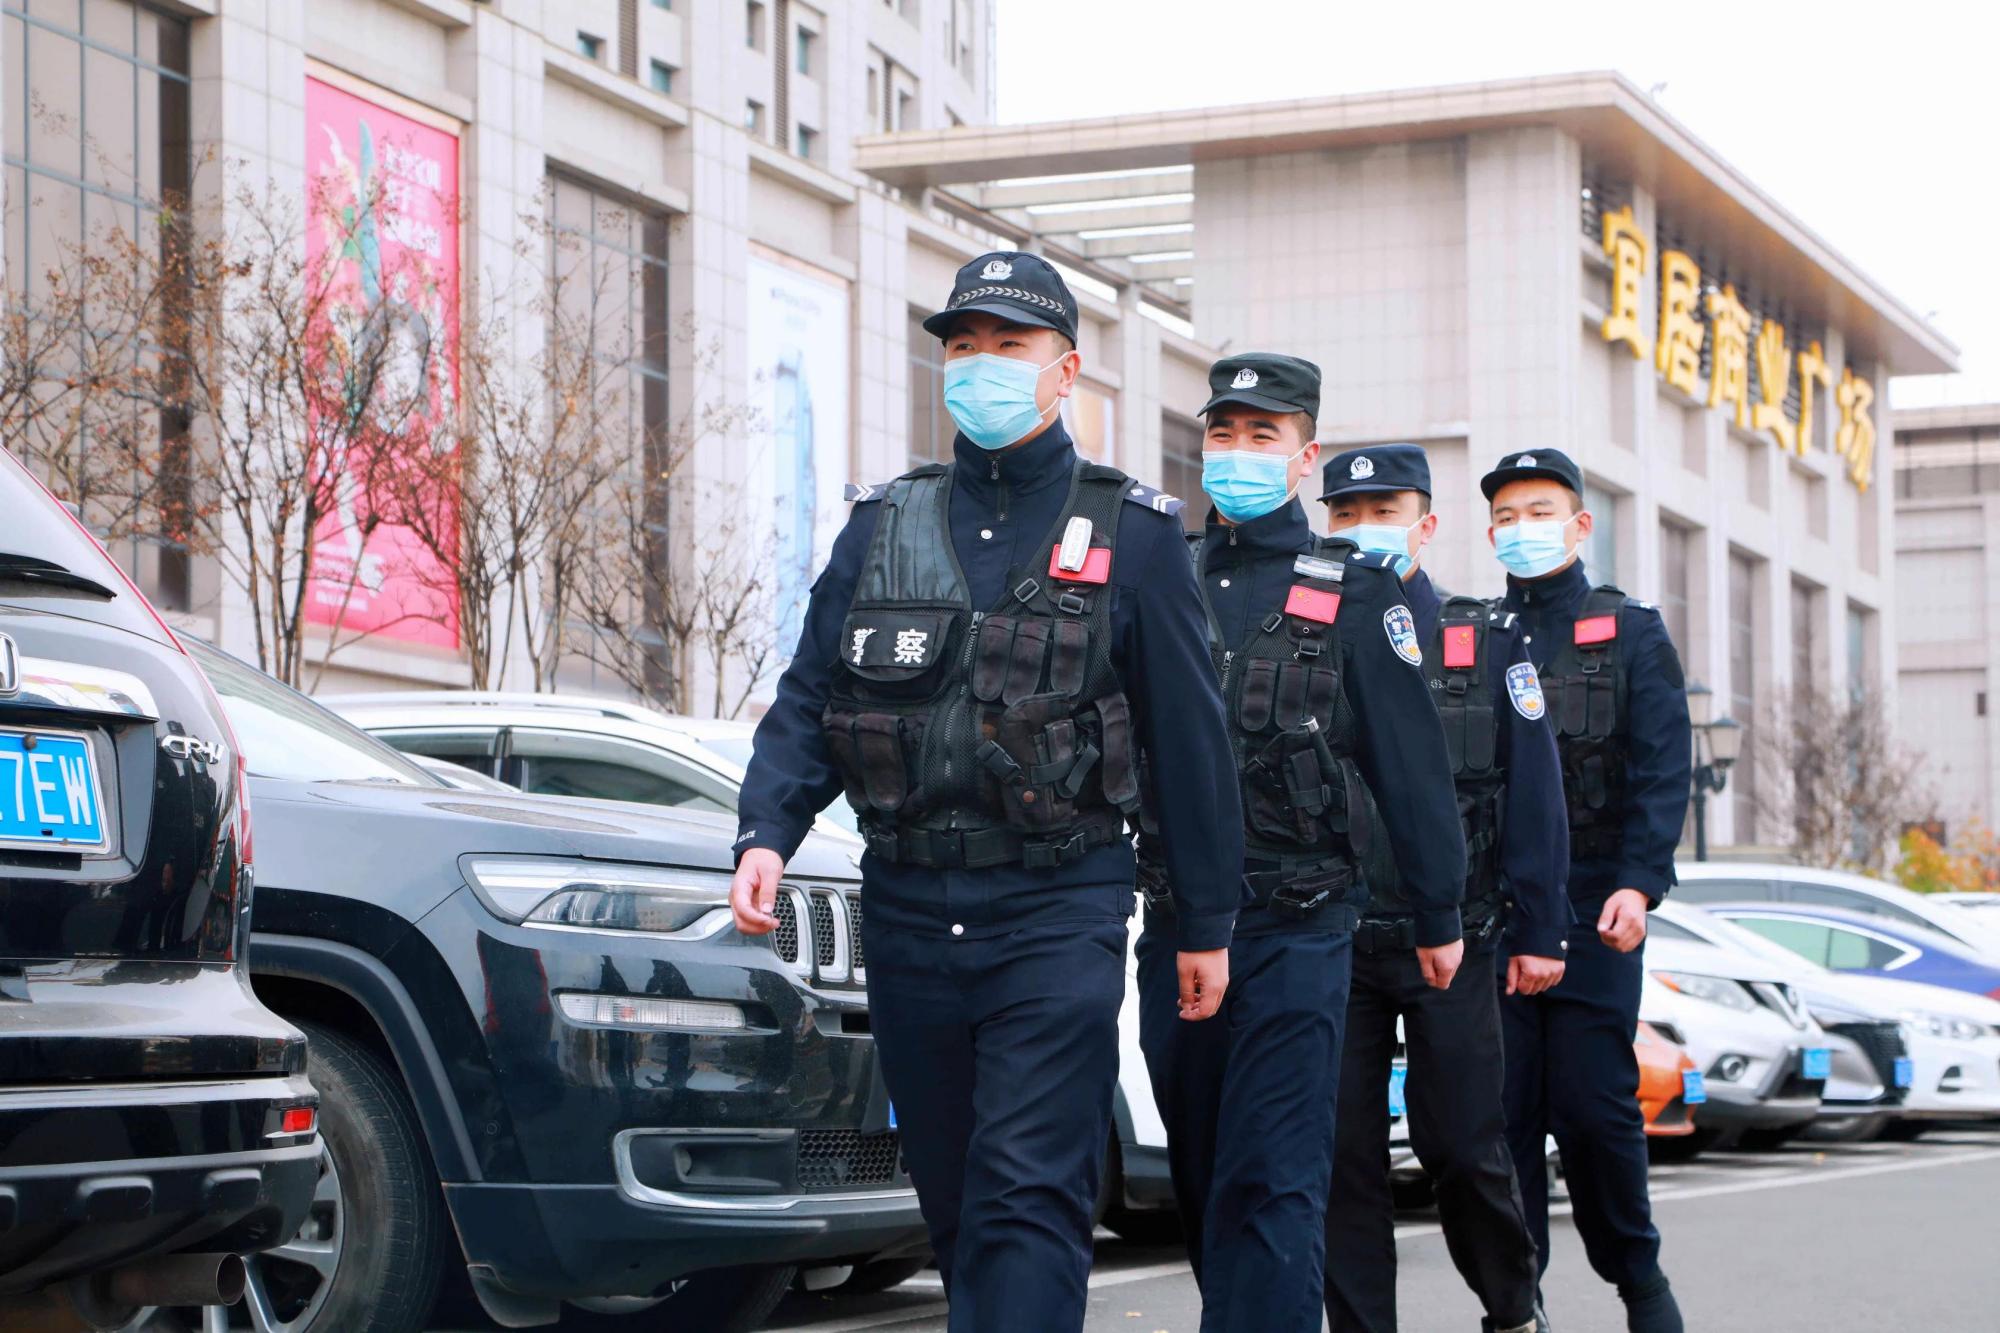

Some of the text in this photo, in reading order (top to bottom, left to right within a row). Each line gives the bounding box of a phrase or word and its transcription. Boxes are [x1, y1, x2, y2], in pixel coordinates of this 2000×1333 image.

[1602, 204, 1877, 494] 宜居商业广场
[0, 751, 92, 826] 7EW
